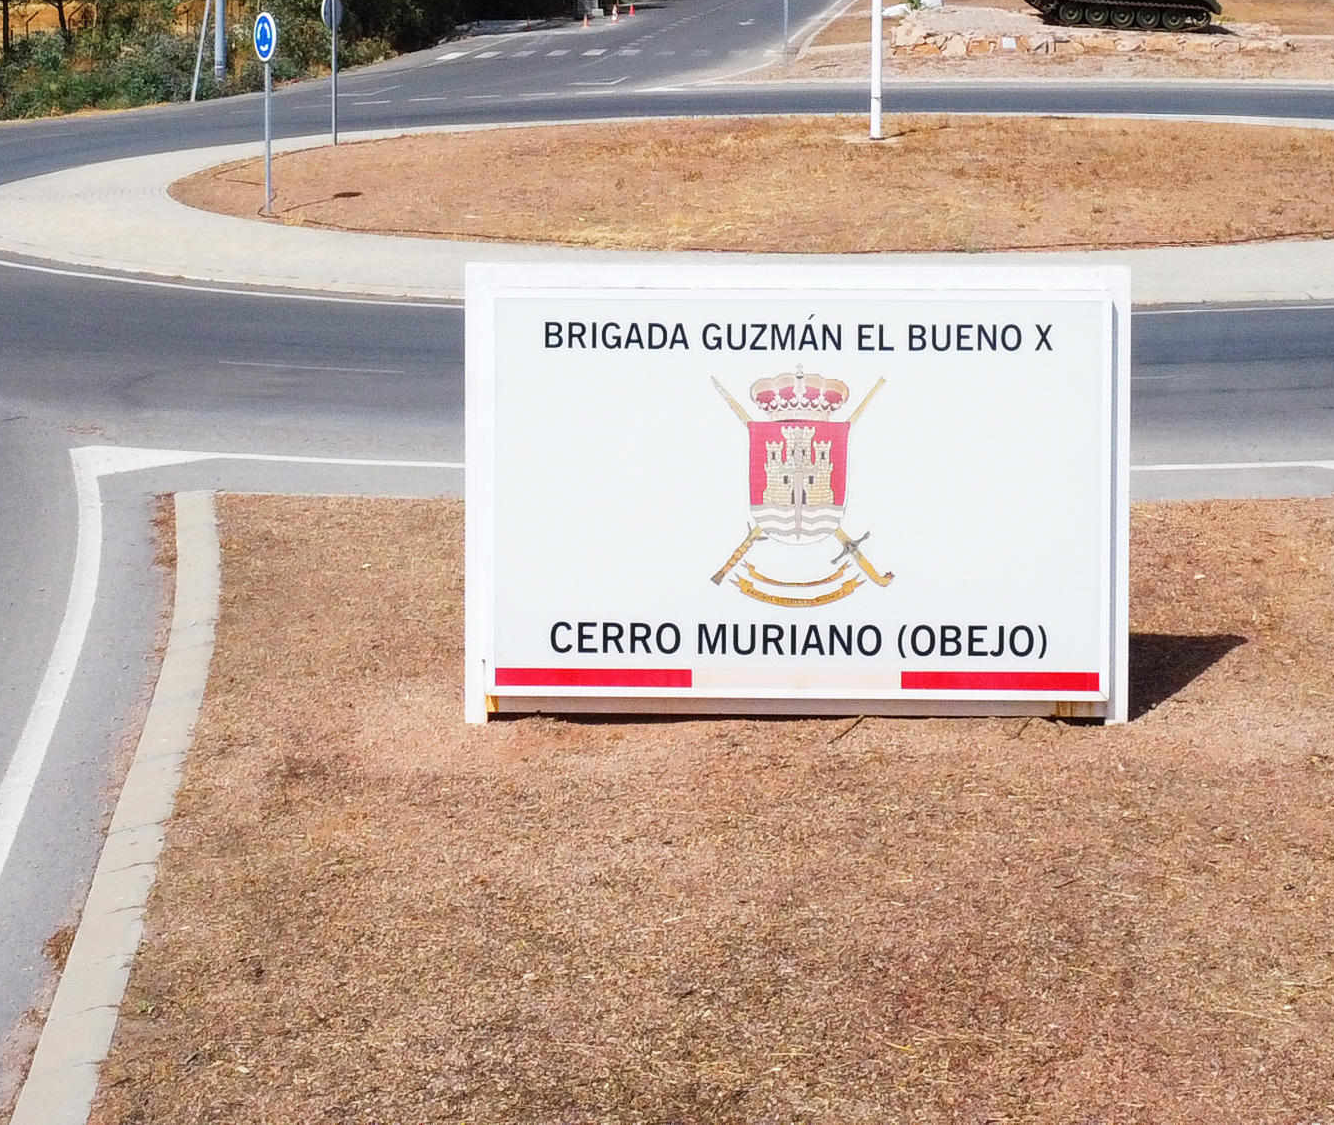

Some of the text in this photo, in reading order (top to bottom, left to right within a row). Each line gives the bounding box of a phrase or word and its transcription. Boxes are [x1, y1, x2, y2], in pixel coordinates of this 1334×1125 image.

[544, 314, 1054, 352] BRIGADA GUZMÁN EL BUENO X
[550, 621, 1049, 659] CERRO MURIANO (OBEJO)
